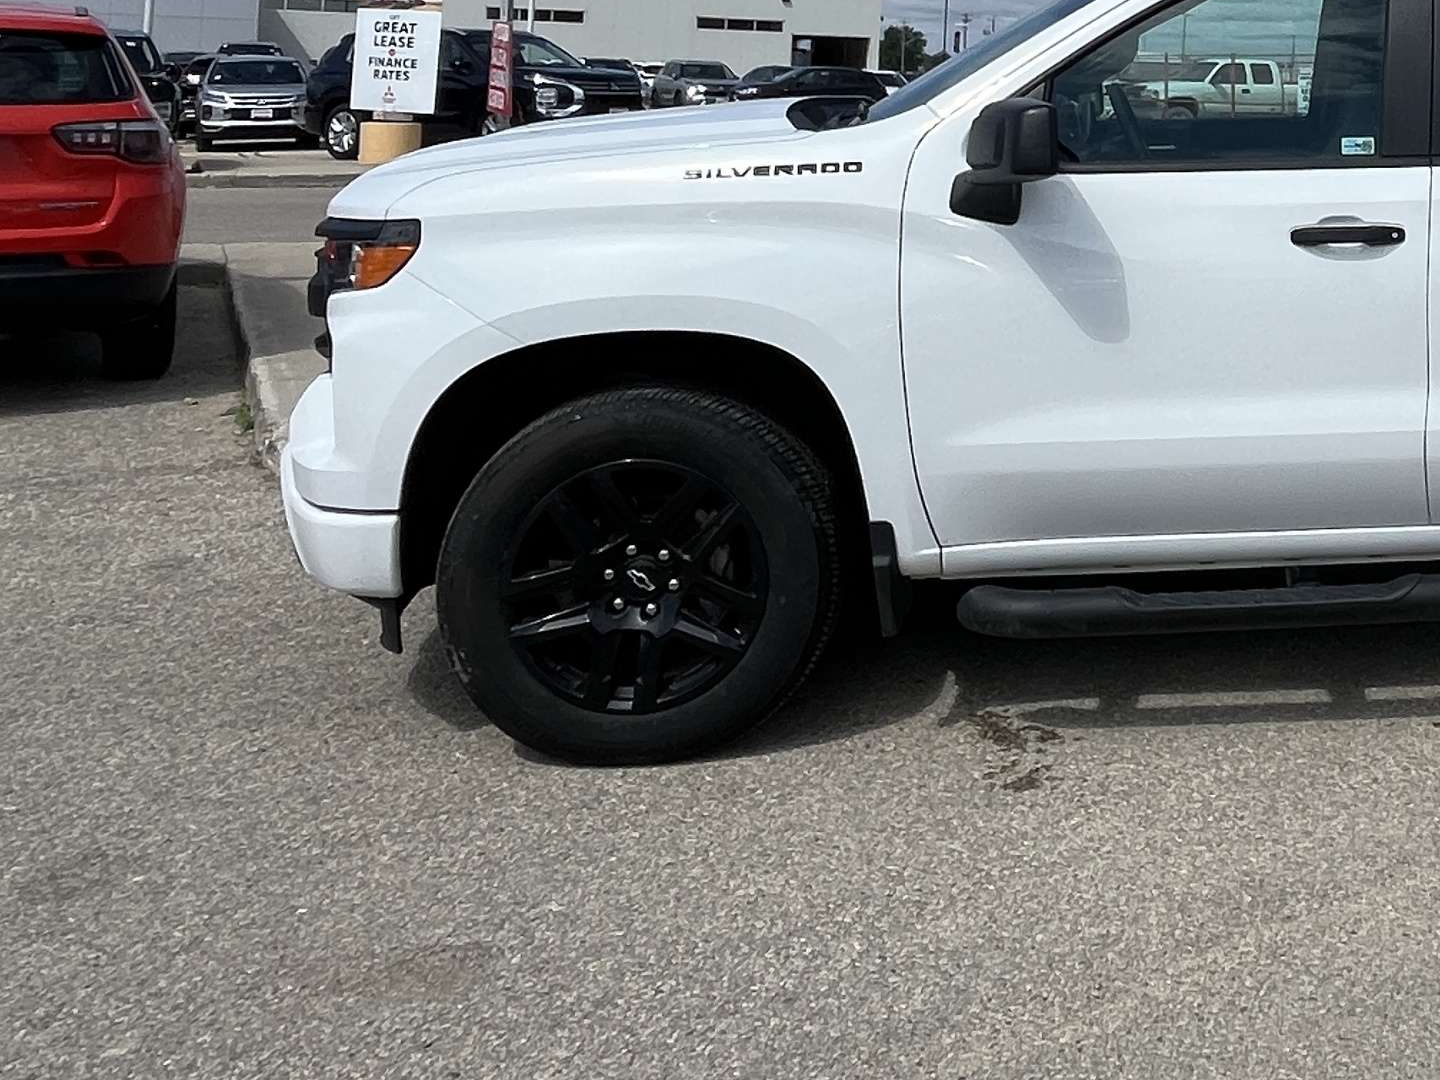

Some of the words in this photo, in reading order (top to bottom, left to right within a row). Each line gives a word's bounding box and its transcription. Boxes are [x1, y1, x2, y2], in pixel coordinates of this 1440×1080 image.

[374, 21, 418, 34] GREAT
[374, 35, 415, 48] LEASE
[368, 56, 418, 69] FINANCE
[373, 70, 410, 81] RATES
[683, 161, 863, 180] SILVERADO
